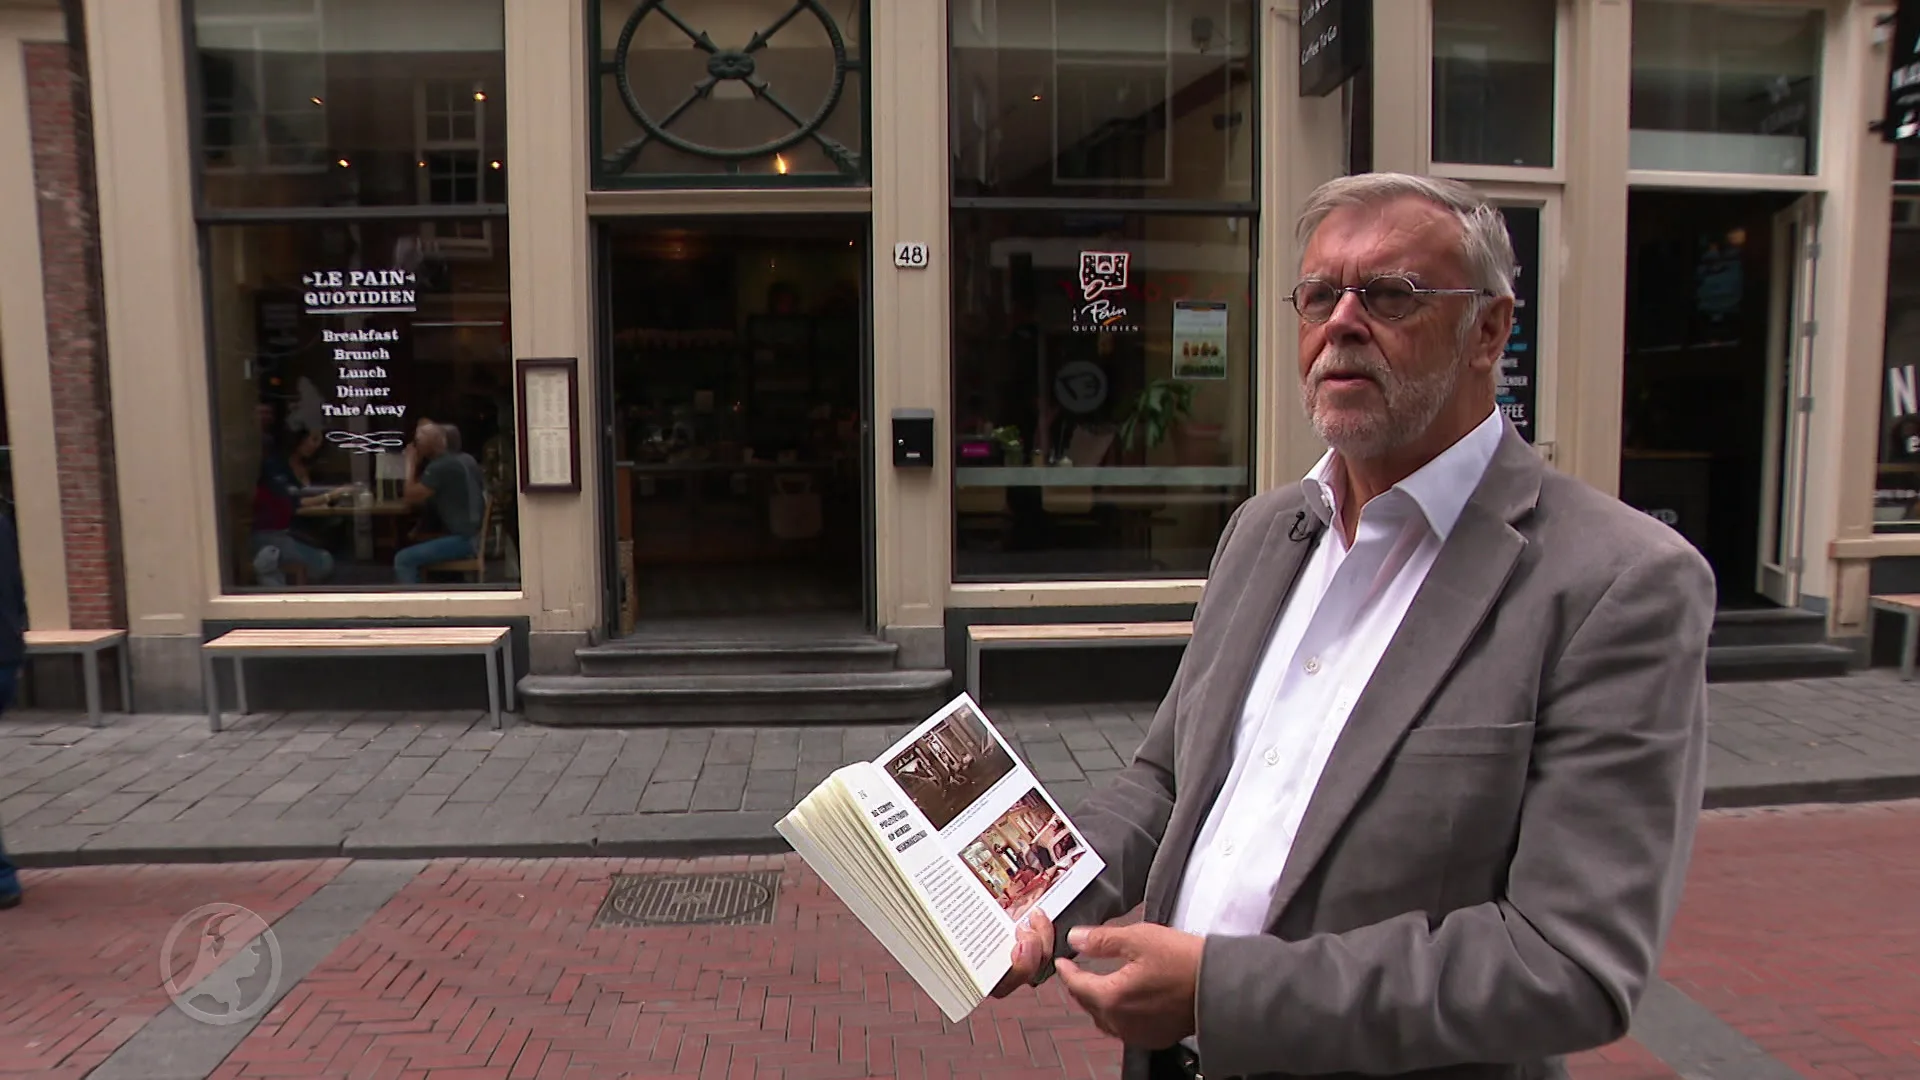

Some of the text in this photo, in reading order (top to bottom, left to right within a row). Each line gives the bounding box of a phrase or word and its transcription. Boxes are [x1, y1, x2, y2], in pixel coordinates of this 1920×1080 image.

[899, 246, 923, 264] 48
[312, 269, 406, 287] LE PAIN
[304, 290, 416, 305] QUOTIDIEN
[1081, 299, 1128, 323] Pain
[322, 329, 399, 342] Breakfast
[333, 347, 390, 360] Brunch
[338, 366, 387, 379] Lunch
[336, 385, 391, 398] Dinner
[321, 403, 406, 418] Take Away
